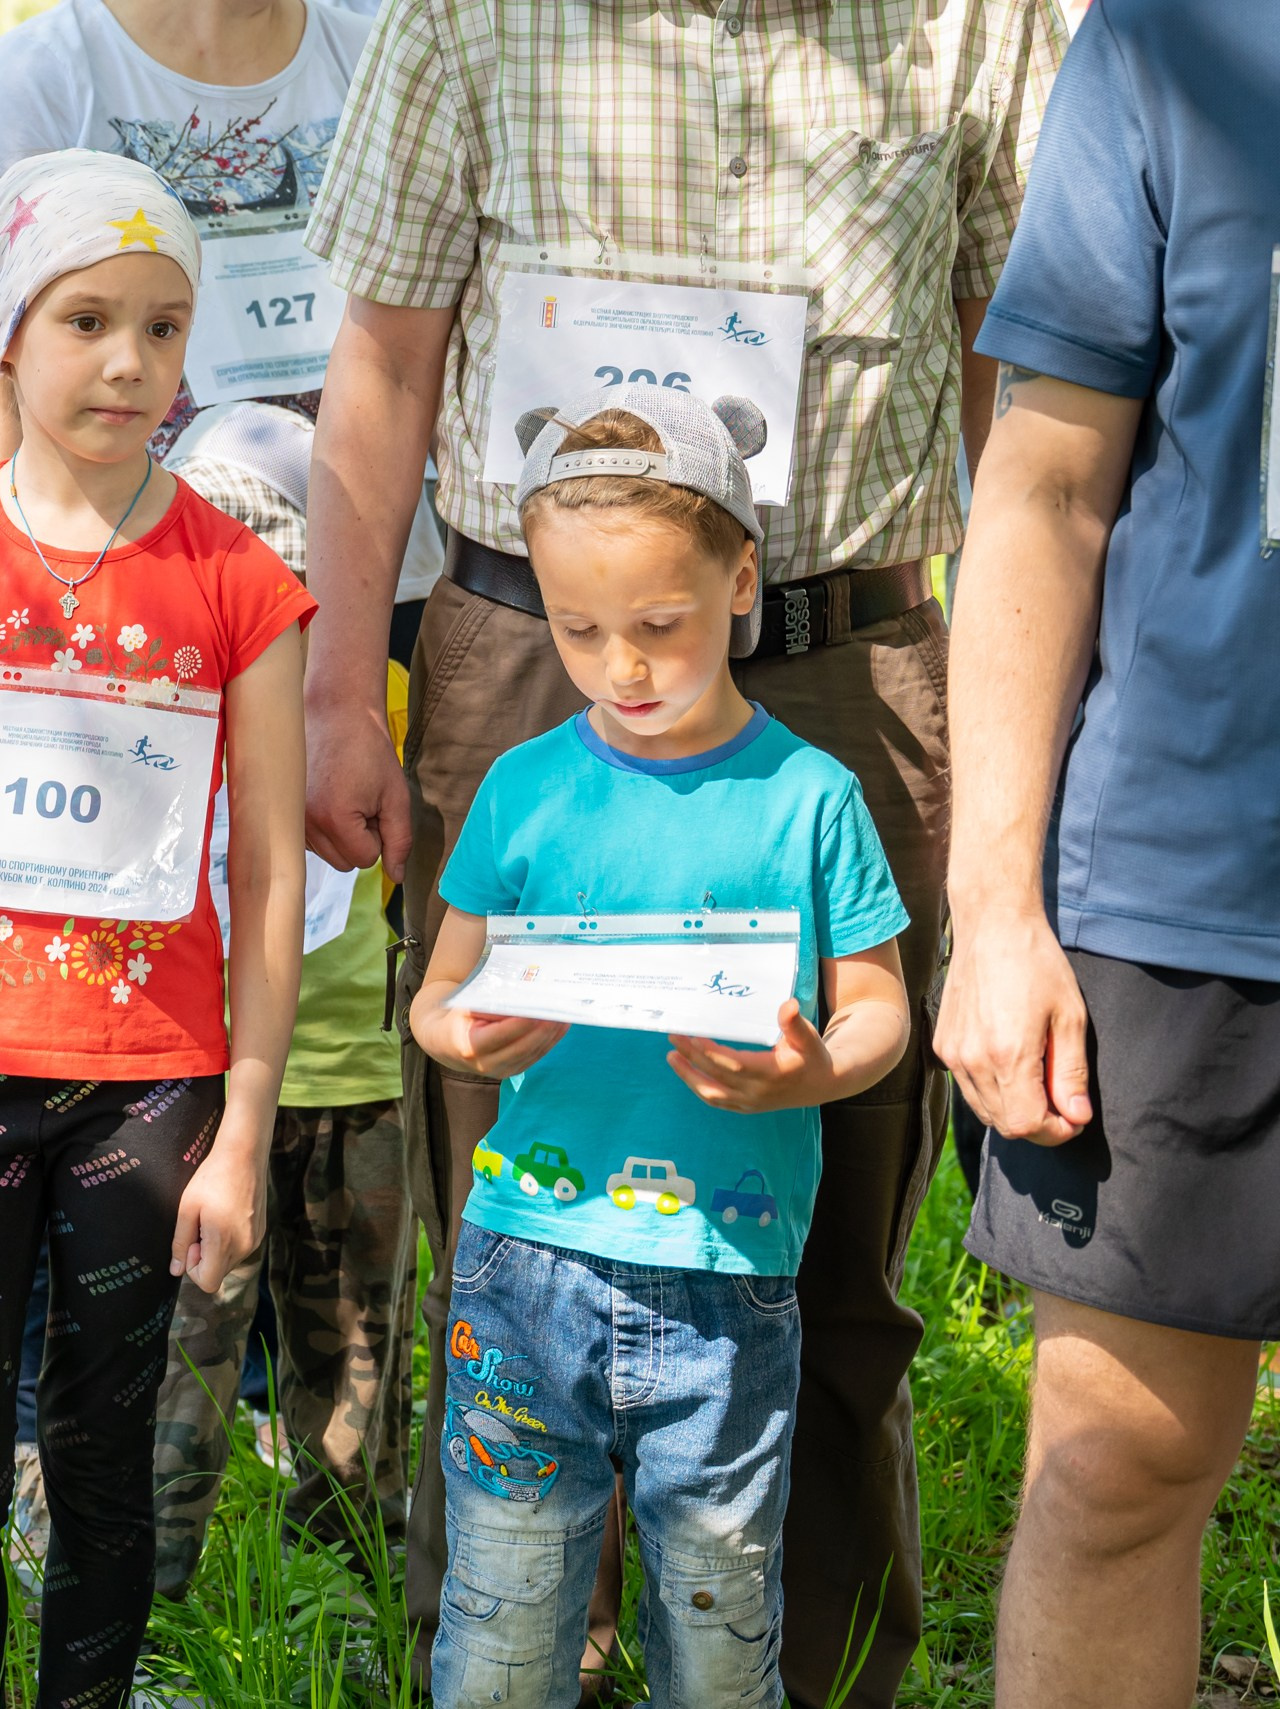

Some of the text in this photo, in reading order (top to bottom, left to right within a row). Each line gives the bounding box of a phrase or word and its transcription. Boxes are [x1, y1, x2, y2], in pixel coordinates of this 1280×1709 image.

[245, 292, 316, 329] 127
[784, 599, 798, 648] HUGO
[797, 596, 811, 647] BOSS
[4, 777, 102, 824] 100
[8, 861, 67, 877] СПОРТИВНОМУ
[25, 874, 38, 886] МО
[47, 877, 86, 891] КОЛПИНО
[88, 881, 108, 894] 2024
[129, 1078, 174, 1117] UNICOR
[70, 1148, 127, 1177] FOREVER
[80, 1157, 141, 1189] UNICORN
[1038, 1211, 1092, 1239] Kalenji
[78, 1255, 140, 1285] UNICORN
[89, 1264, 152, 1296] FOREVER
[450, 1320, 480, 1360] Car
[466, 1347, 535, 1397] Show
[513, 1407, 548, 1433] Green
